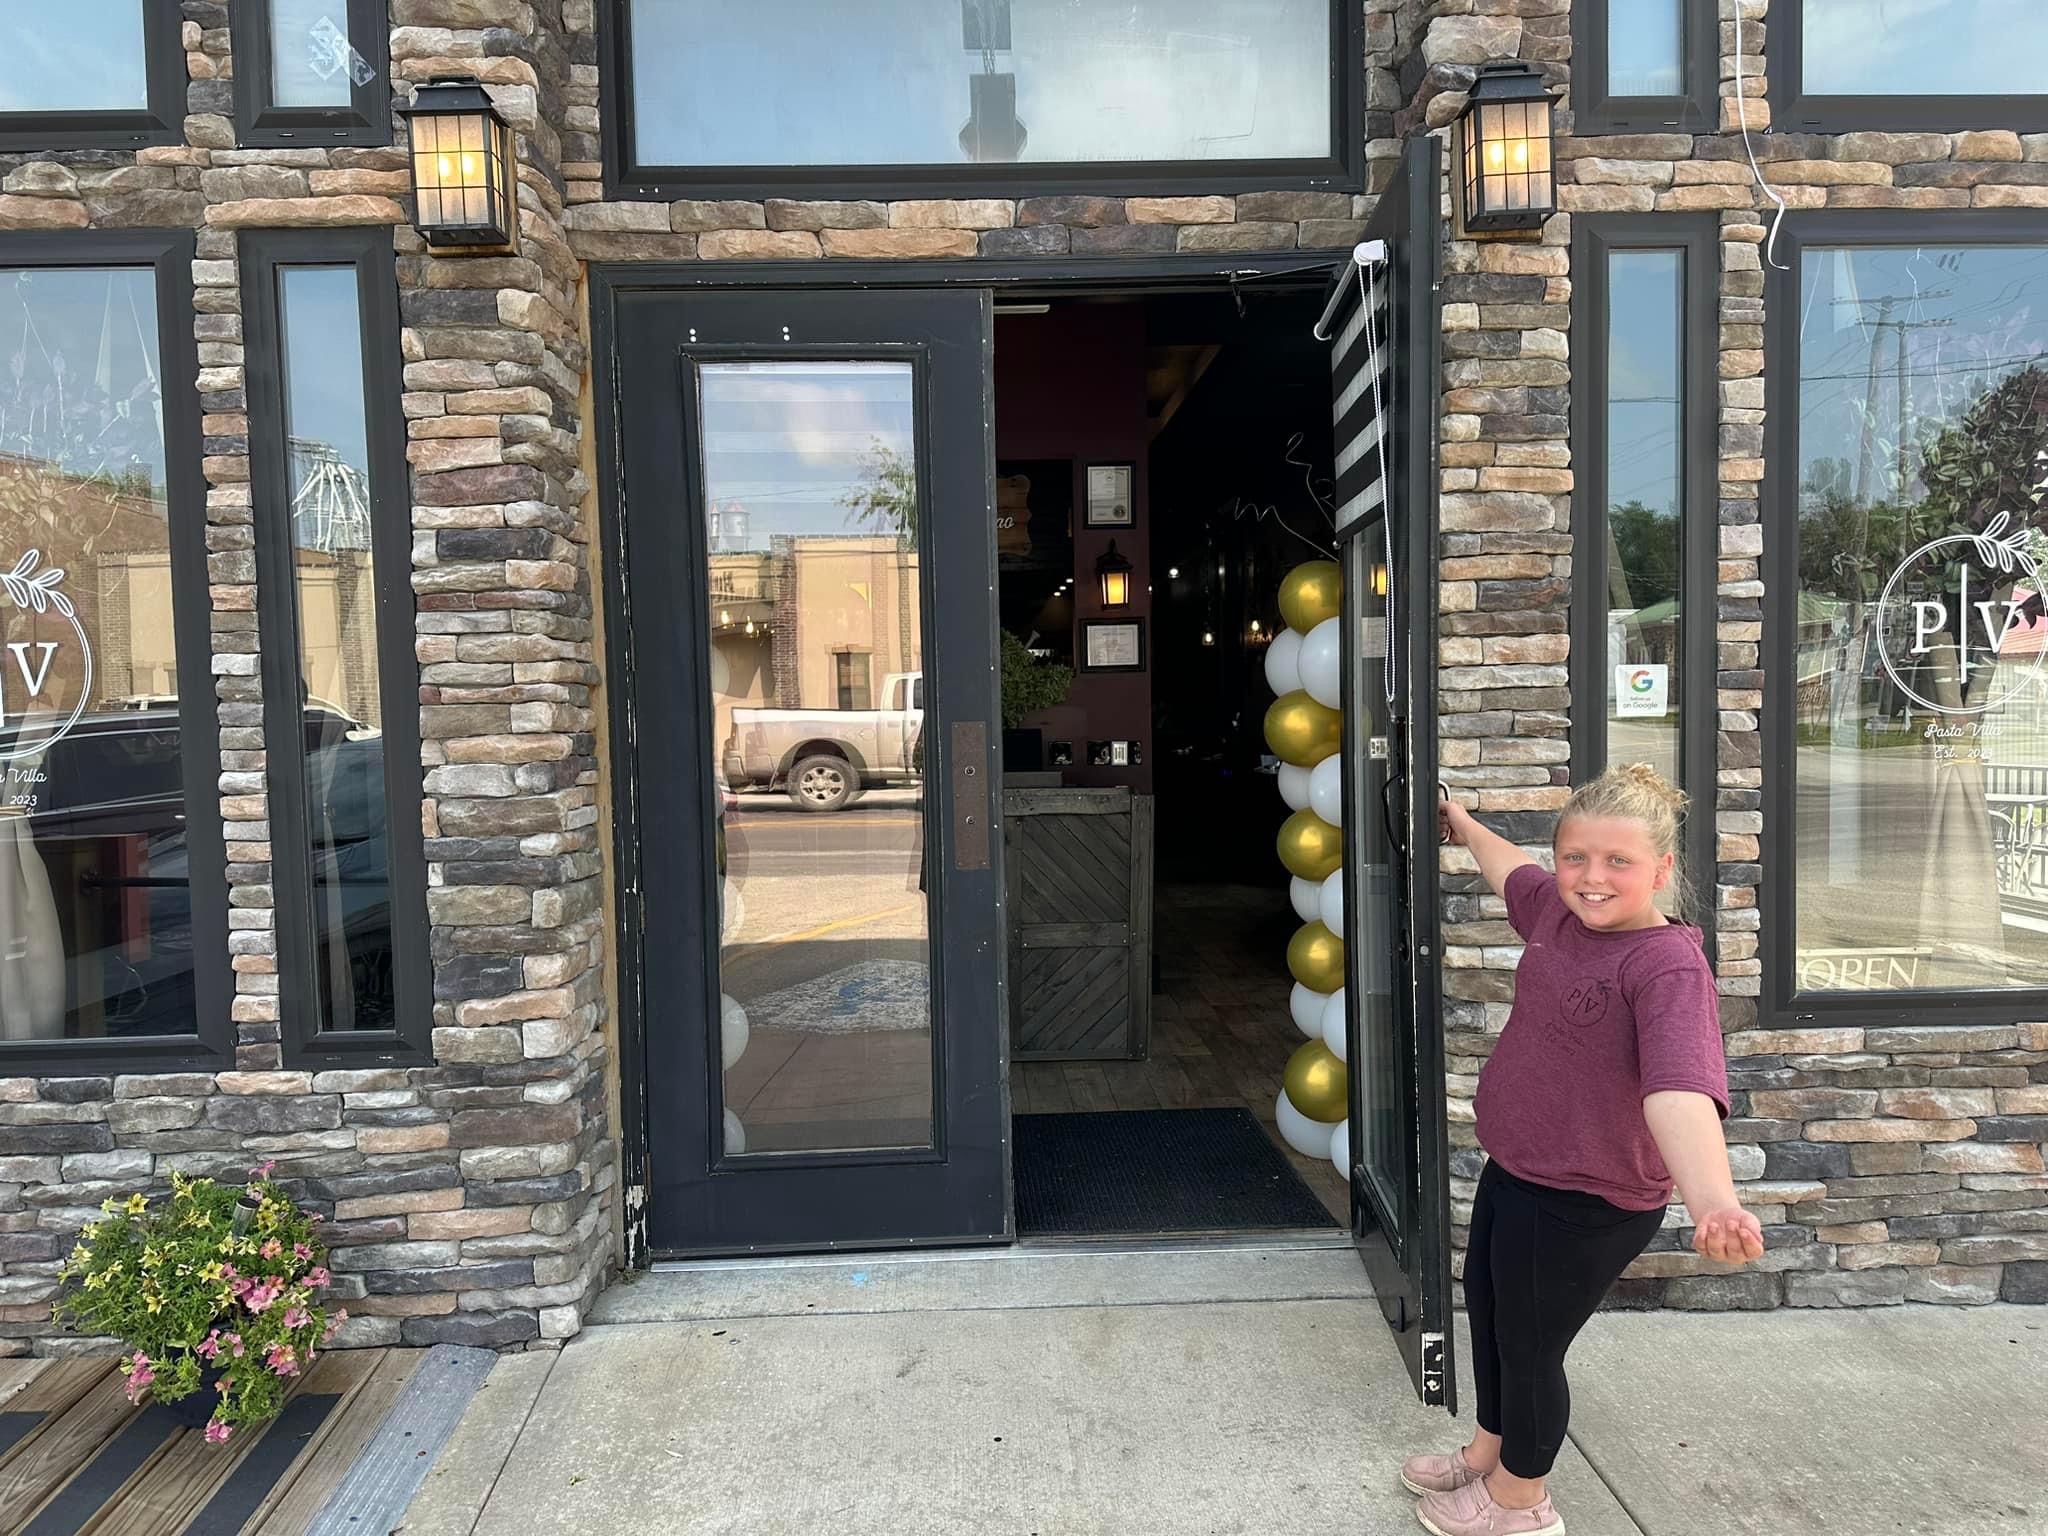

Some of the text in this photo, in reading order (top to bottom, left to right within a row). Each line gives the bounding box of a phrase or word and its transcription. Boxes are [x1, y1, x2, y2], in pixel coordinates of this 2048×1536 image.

[1631, 670, 1653, 692] G
[1924, 722, 2003, 737] Pasta Villa
[1934, 745, 1958, 758] Est.
[8, 769, 47, 782] Villa
[10, 795, 37, 806] 2023
[1801, 957, 1918, 990] OPEN
